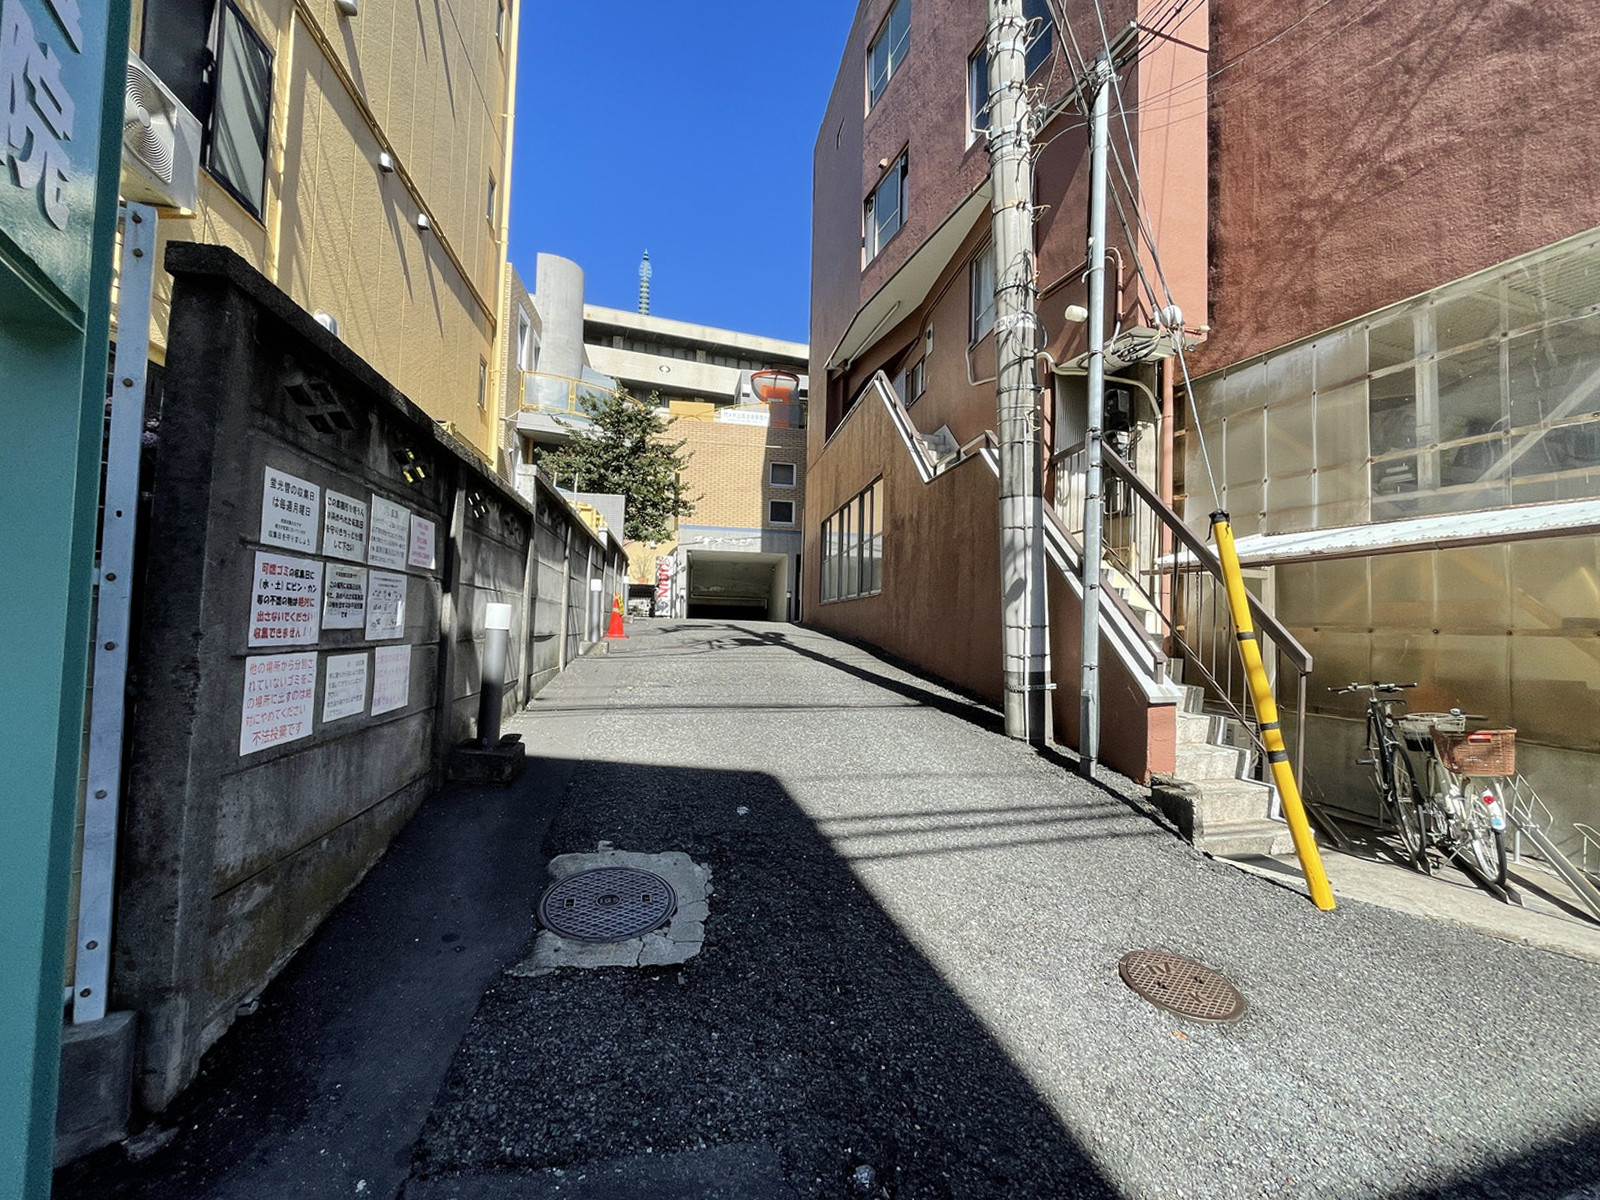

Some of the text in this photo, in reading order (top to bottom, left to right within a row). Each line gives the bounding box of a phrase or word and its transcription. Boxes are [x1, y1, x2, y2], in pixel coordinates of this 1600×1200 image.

[256, 610, 314, 622] 出さないでください
